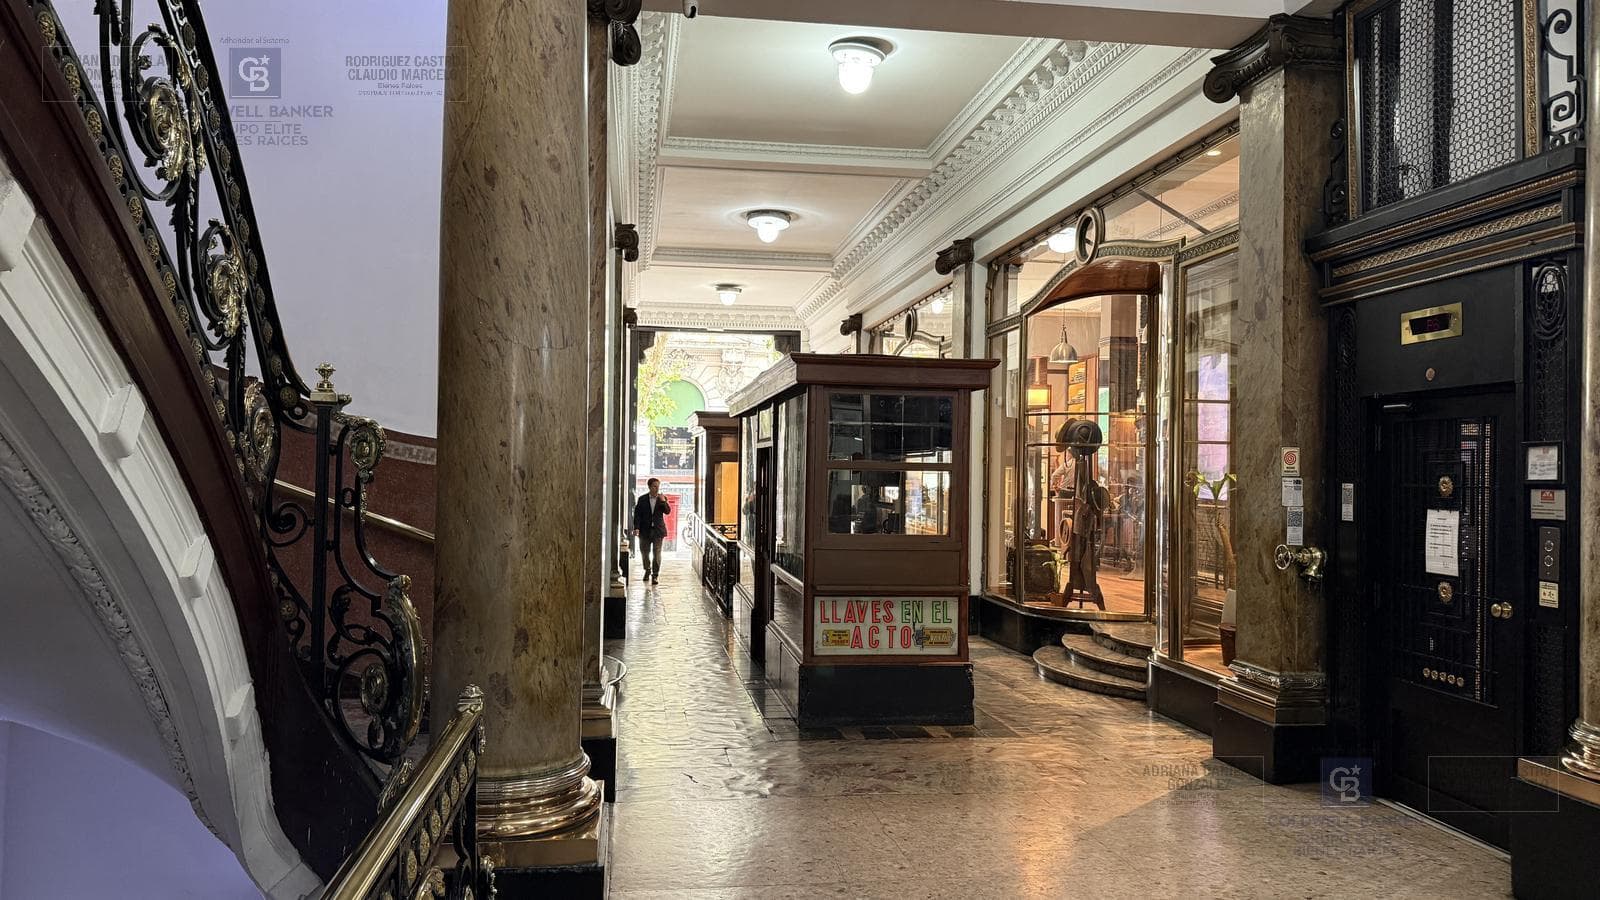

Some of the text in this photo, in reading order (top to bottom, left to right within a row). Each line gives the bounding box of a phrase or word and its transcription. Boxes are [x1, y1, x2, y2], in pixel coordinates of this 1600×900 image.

[819, 600, 953, 624] LLAVES EN EL
[850, 626, 912, 649] ACTO
